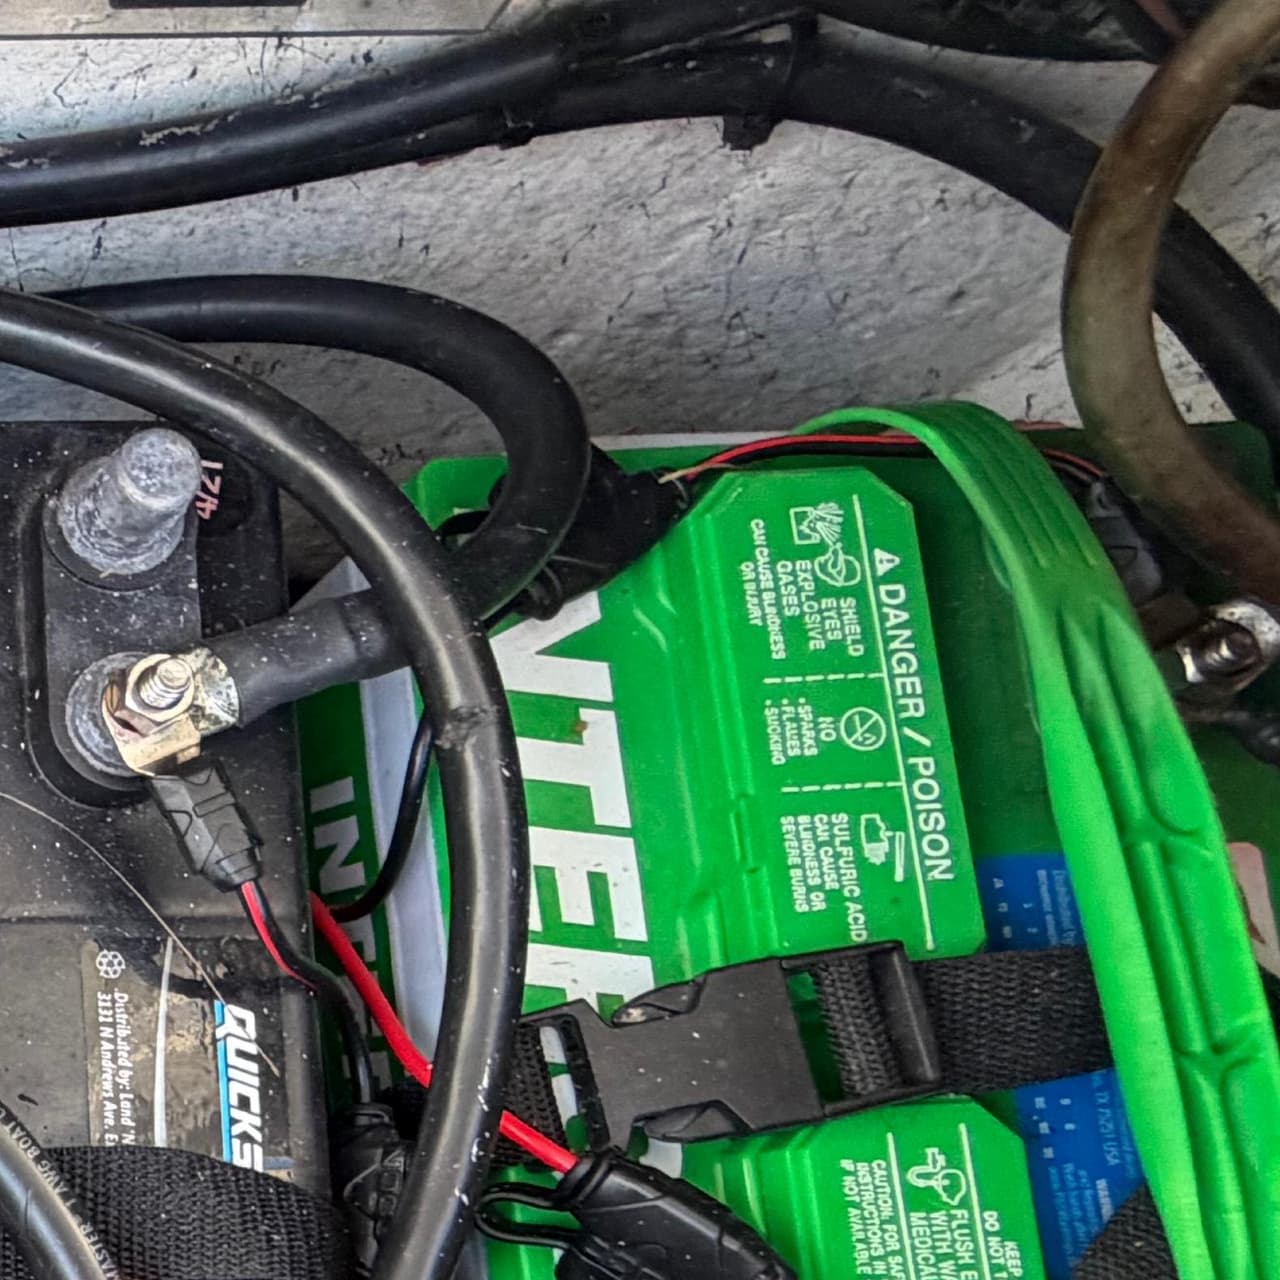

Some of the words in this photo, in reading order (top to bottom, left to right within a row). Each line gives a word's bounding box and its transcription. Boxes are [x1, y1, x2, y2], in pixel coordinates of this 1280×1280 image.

[776, 560, 800, 616] GASES
[796, 560, 825, 650] EXPLOSIVE
[820, 597, 842, 640] EYES
[834, 597, 864, 656] SHIELD
[818, 717, 836, 741] NO
[877, 583, 926, 719] DANGER
[911, 757, 955, 882] POISON
[830, 813, 861, 897] SULFURIC
[843, 901, 868, 942] ACID
[97, 992, 110, 1022] 3131
[99, 1026, 111, 1038] N
[100, 1041, 115, 1098] Andrews
[116, 1070, 131, 1091] by:
[103, 1101, 116, 1129] Ave.
[119, 1093, 134, 1125] Land
[3, 1119, 40, 1162] BOAT
[930, 1210, 956, 1257] WITH
[949, 1209, 977, 1266] FLUSH
[982, 1210, 1002, 1232] DO
[986, 1235, 1007, 1267] NOT
[1003, 1241, 1024, 1278] KEEP
